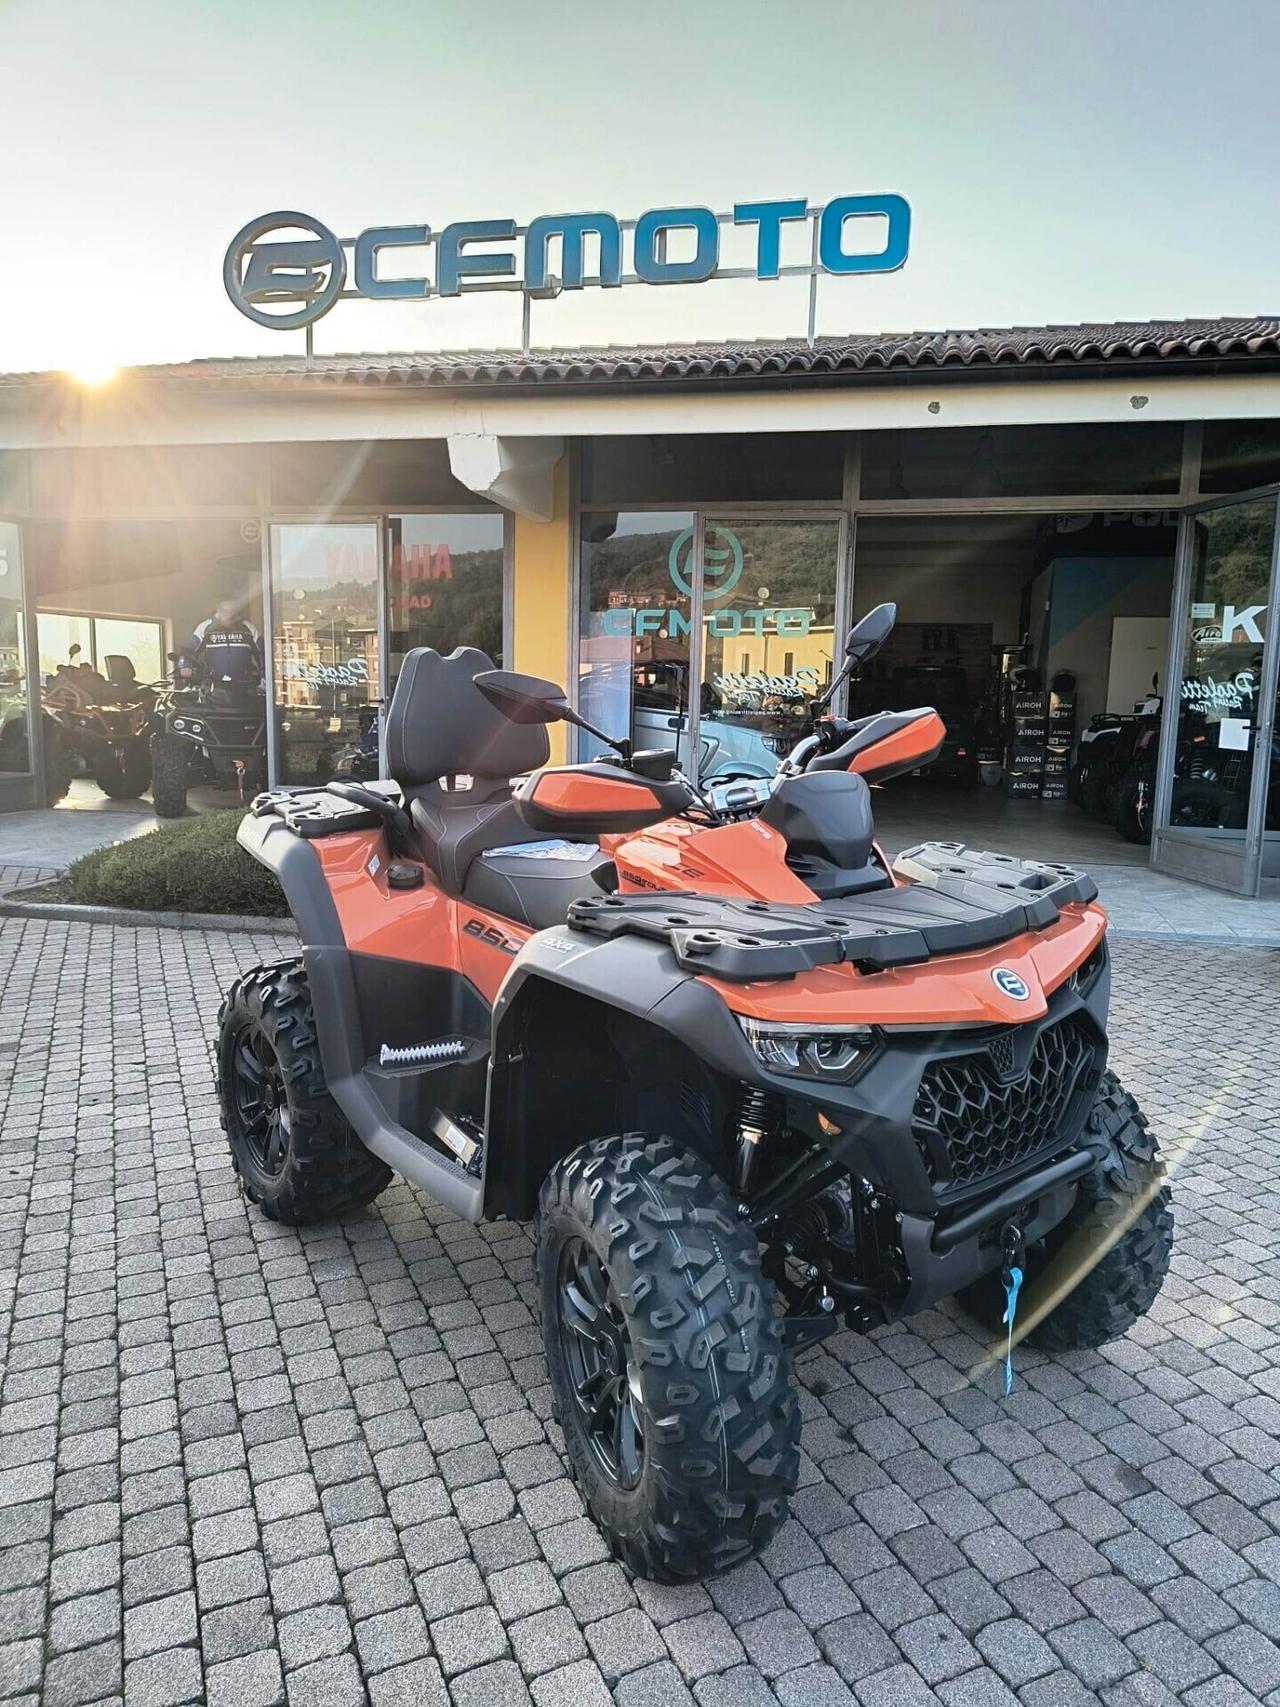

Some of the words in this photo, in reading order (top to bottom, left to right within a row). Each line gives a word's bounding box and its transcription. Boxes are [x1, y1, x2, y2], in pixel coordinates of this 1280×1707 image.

[354, 191, 911, 299] CFMOTO
[603, 608, 810, 638] CFMOTO
[1194, 627, 1222, 639] Airo
[1221, 605, 1268, 643] K
